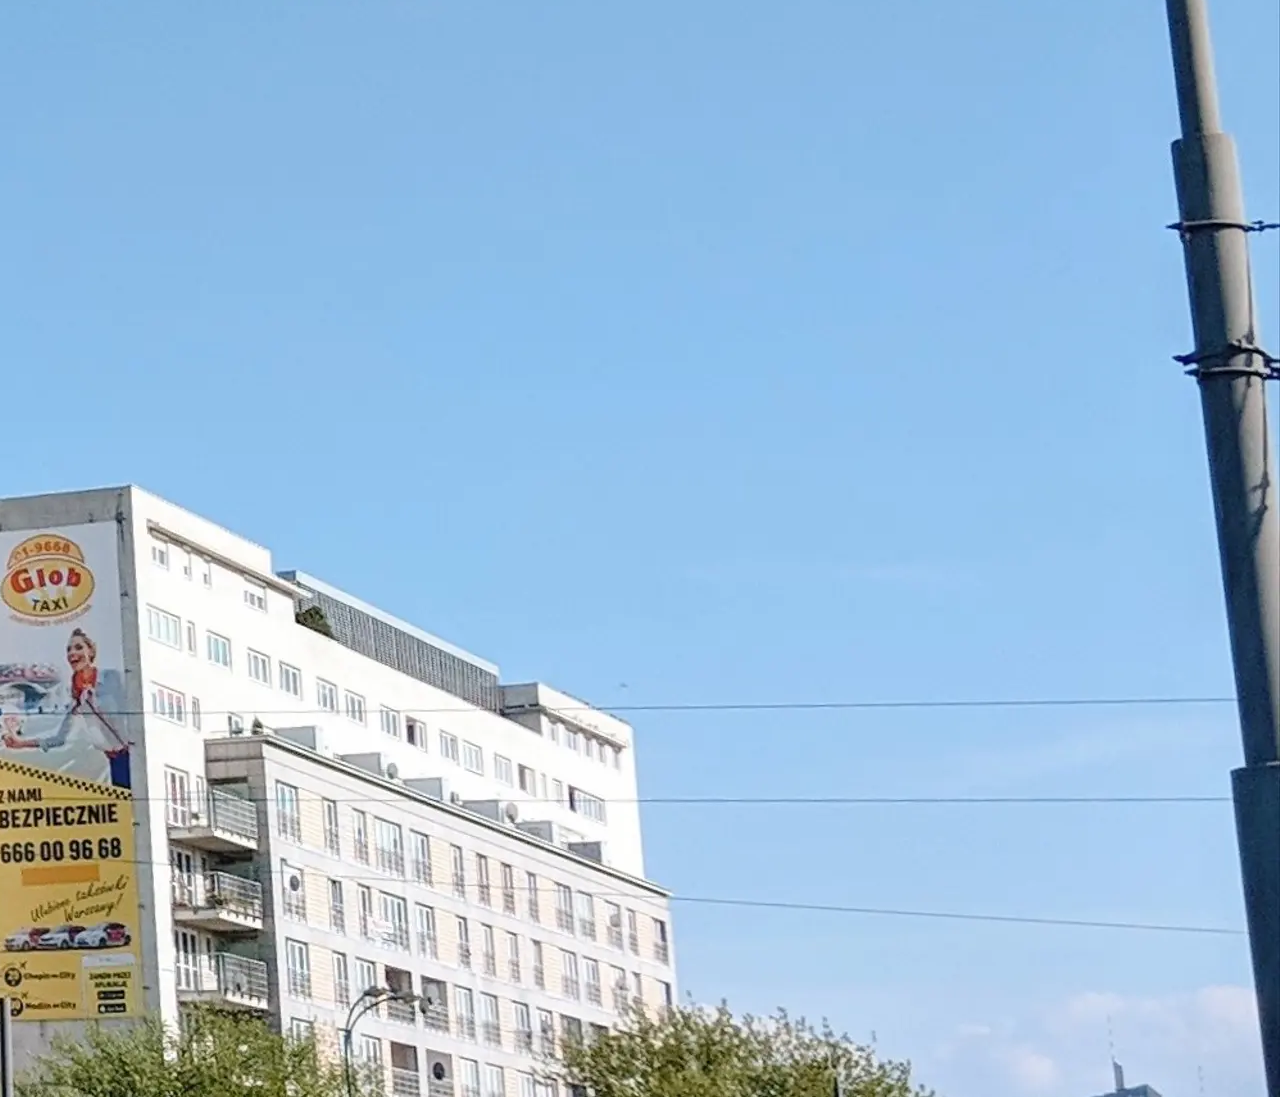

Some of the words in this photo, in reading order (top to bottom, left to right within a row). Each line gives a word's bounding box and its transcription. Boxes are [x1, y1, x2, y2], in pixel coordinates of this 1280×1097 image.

[10, 568, 82, 594] Glob
[32, 596, 69, 612] TAXI
[7, 788, 42, 803] NAMI
[0, 842, 35, 863] 666
[40, 840, 64, 861] 00
[69, 839, 93, 860] 96
[98, 837, 122, 858] 68
